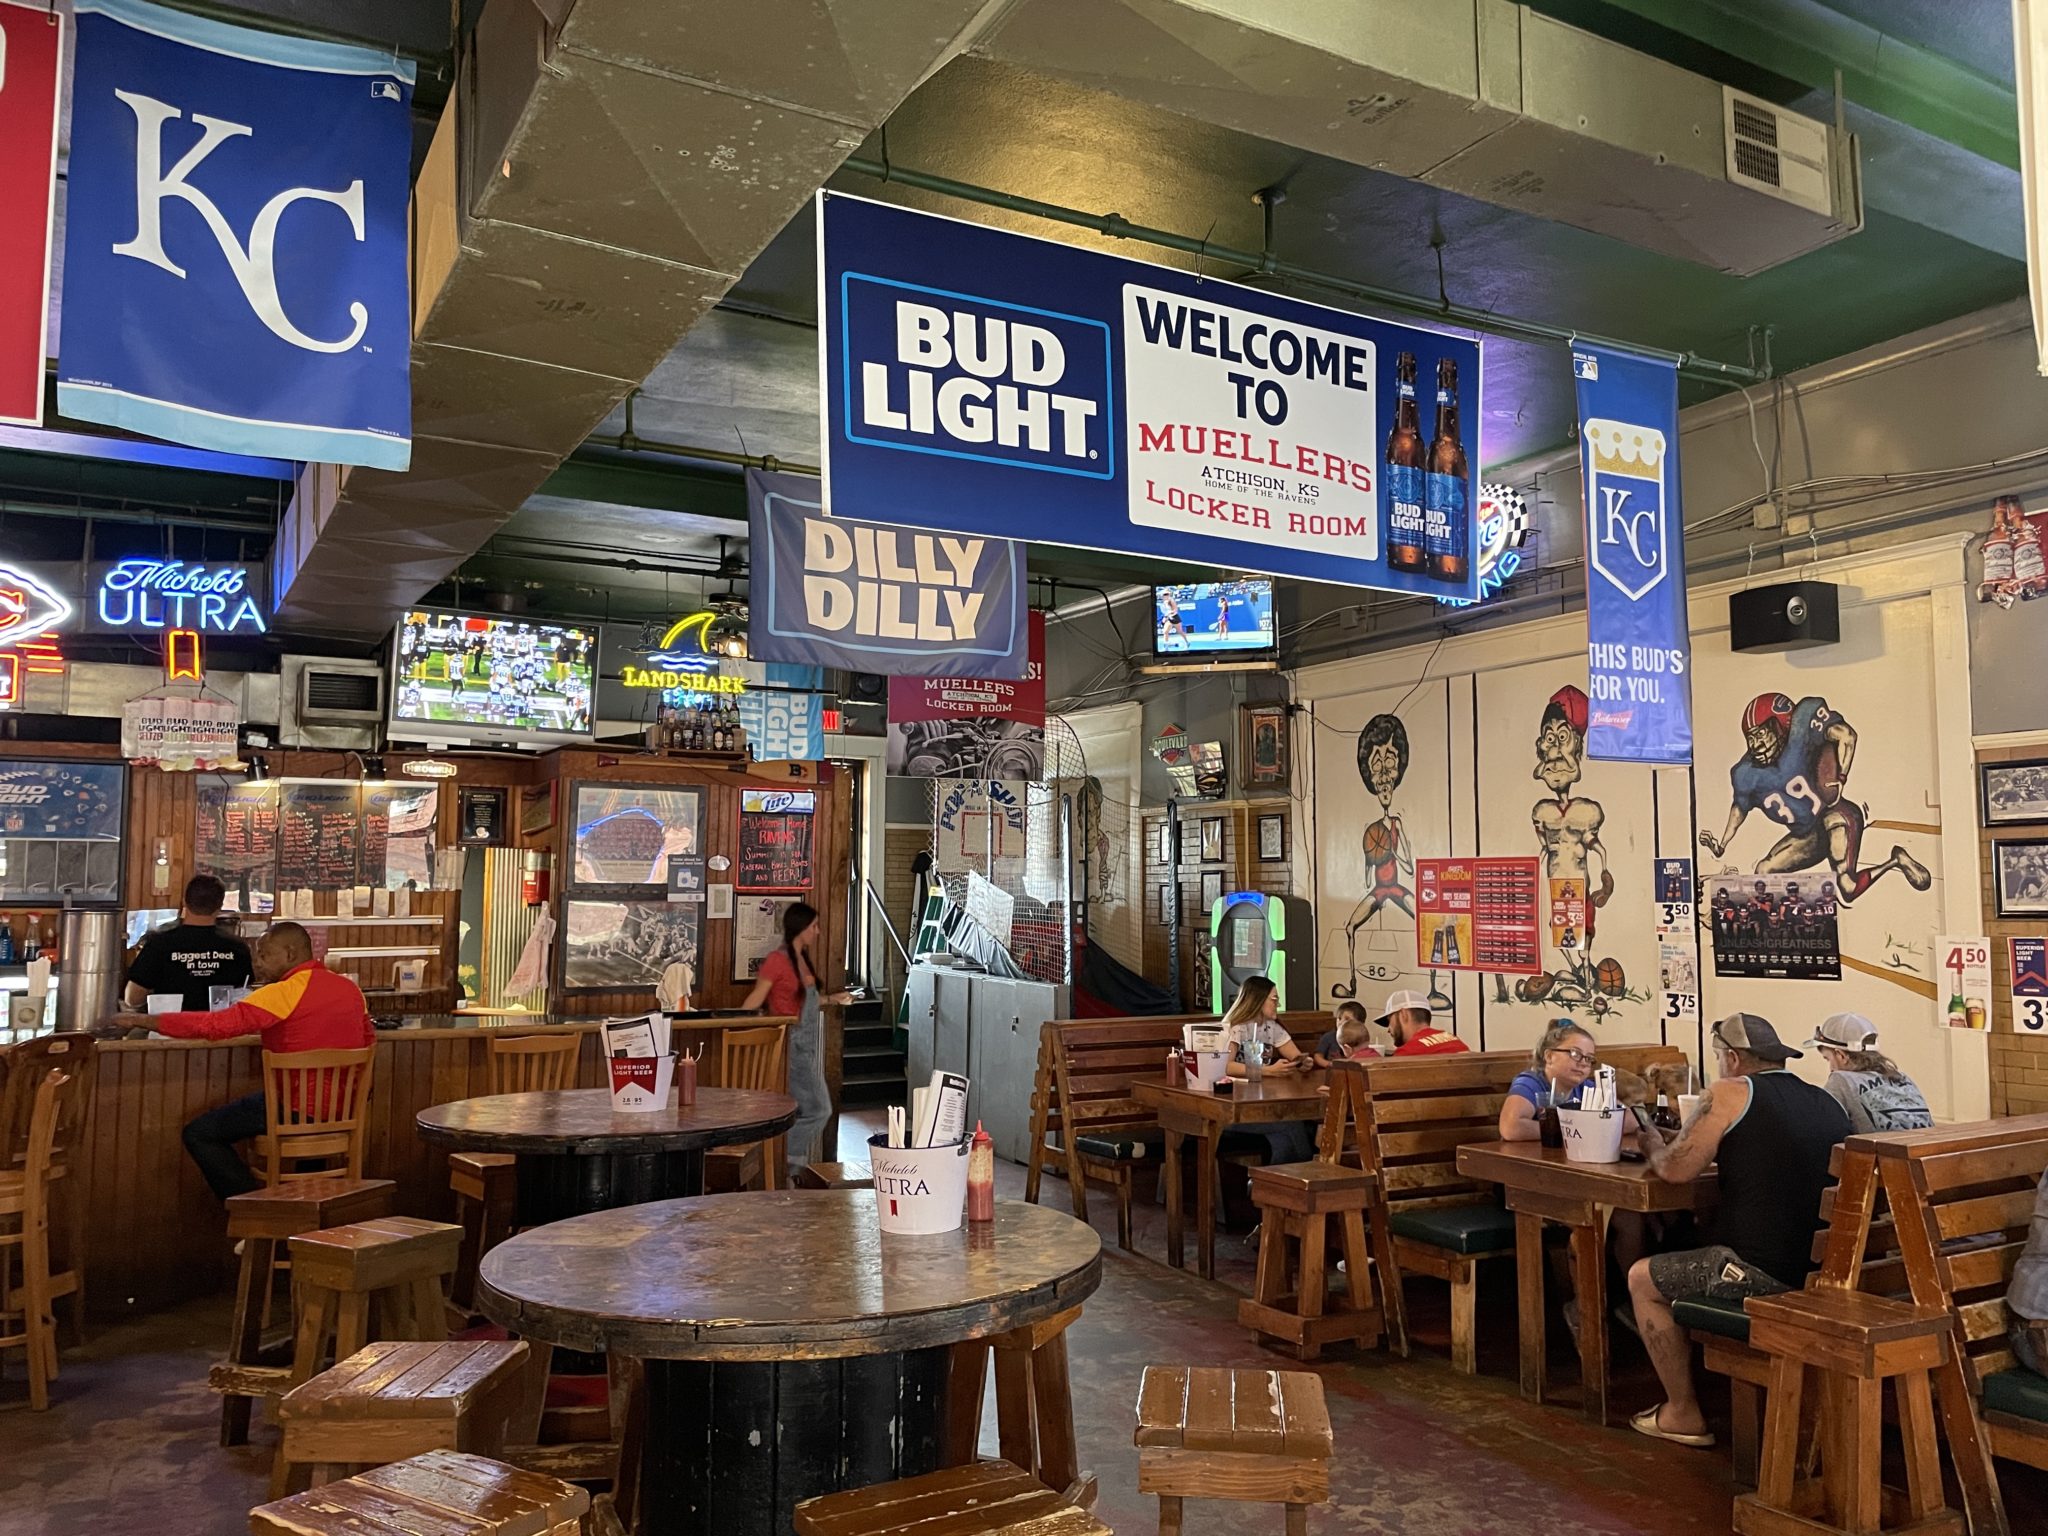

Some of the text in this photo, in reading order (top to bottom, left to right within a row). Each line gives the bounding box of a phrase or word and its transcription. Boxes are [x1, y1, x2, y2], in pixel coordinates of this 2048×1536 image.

[112, 88, 369, 354] KC
[896, 300, 1066, 387] BUD
[1136, 295, 1368, 392] WELCOME
[862, 361, 1097, 458] LIGHT
[1227, 371, 1289, 426] TO
[1138, 423, 1372, 493] MUELLER'S
[1201, 465, 1320, 498] ATCHISON, KS
[1204, 479, 1316, 506] HOME OF THE RAVENS
[1146, 479, 1367, 536] LOCKER ROOM
[1390, 514, 1425, 532] LIGHT
[1395, 502, 1421, 519] BUD
[1600, 486, 1658, 568] KC
[803, 517, 985, 588] DILLY
[105, 560, 247, 594] Michelob
[99, 586, 267, 632] ULTRA
[803, 574, 985, 641] DILLY
[1589, 642, 1684, 675] THIS BUD'S
[622, 666, 746, 694] LANDSHARK
[924, 679, 1015, 697] MUELLER'S
[1590, 674, 1665, 704] FOR YOU.
[767, 680, 789, 760] LIGH
[822, 710, 840, 730] XIT
[926, 698, 974, 712] LOCKER
[980, 704, 1012, 712] ROOM
[1592, 711, 1632, 724] Budweiser
[1810, 706, 1830, 732] 39
[789, 694, 809, 760] BUD
[765, 796, 790, 811] Lite
[1763, 775, 1822, 824] 39
[759, 830, 796, 844] RAVENS
[1440, 871, 1472, 880] KINGDOM
[171, 951, 211, 963] Biggest
[197, 960, 220, 969] town
[1368, 965, 1386, 978] BC
[873, 1158, 919, 1176] Michelob
